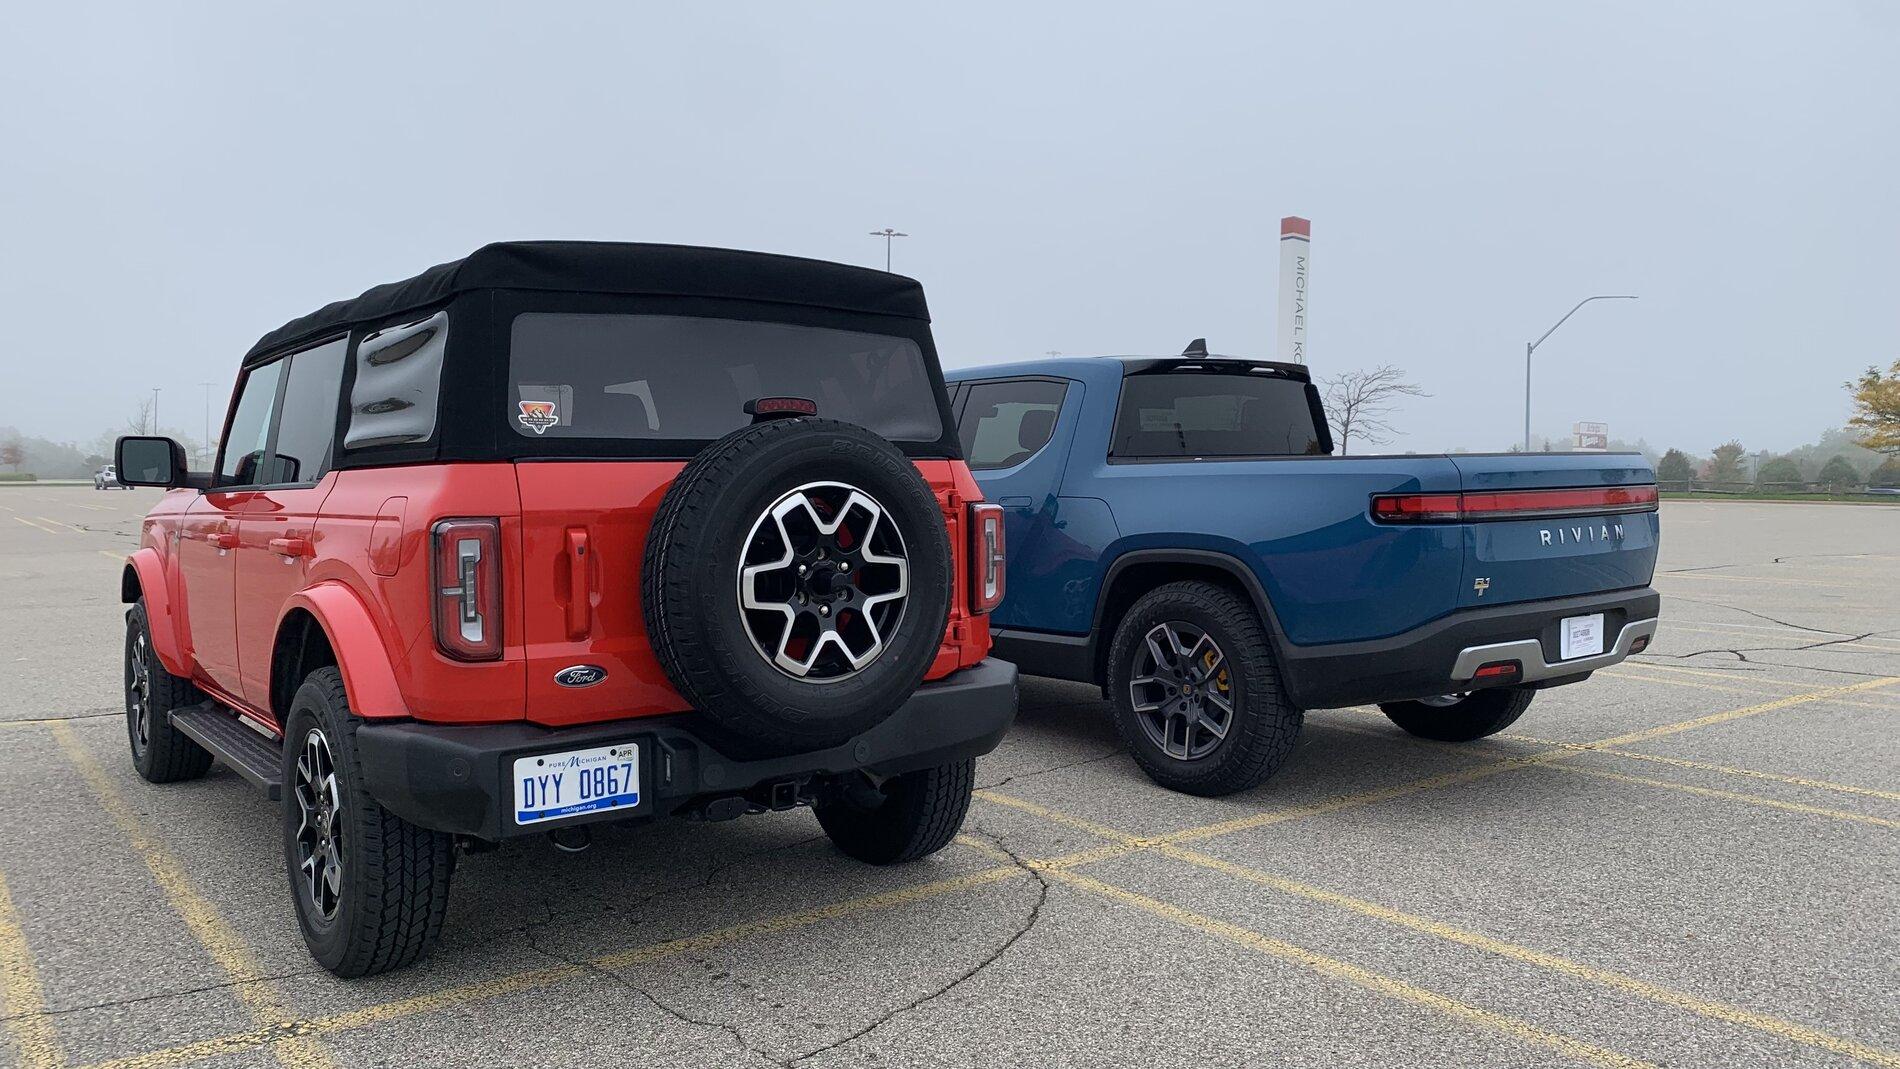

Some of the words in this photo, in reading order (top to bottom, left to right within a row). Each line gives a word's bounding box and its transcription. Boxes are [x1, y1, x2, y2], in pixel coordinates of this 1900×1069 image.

[1295, 256, 1305, 336] MICHAEL
[1539, 524, 1624, 546] RIVIAN
[567, 669, 596, 684] Ford
[618, 749, 633, 759] APR
[548, 761, 566, 769] PURE
[523, 772, 563, 809] DYY
[579, 763, 632, 800] 0867
[560, 803, 597, 814] michigan.org
